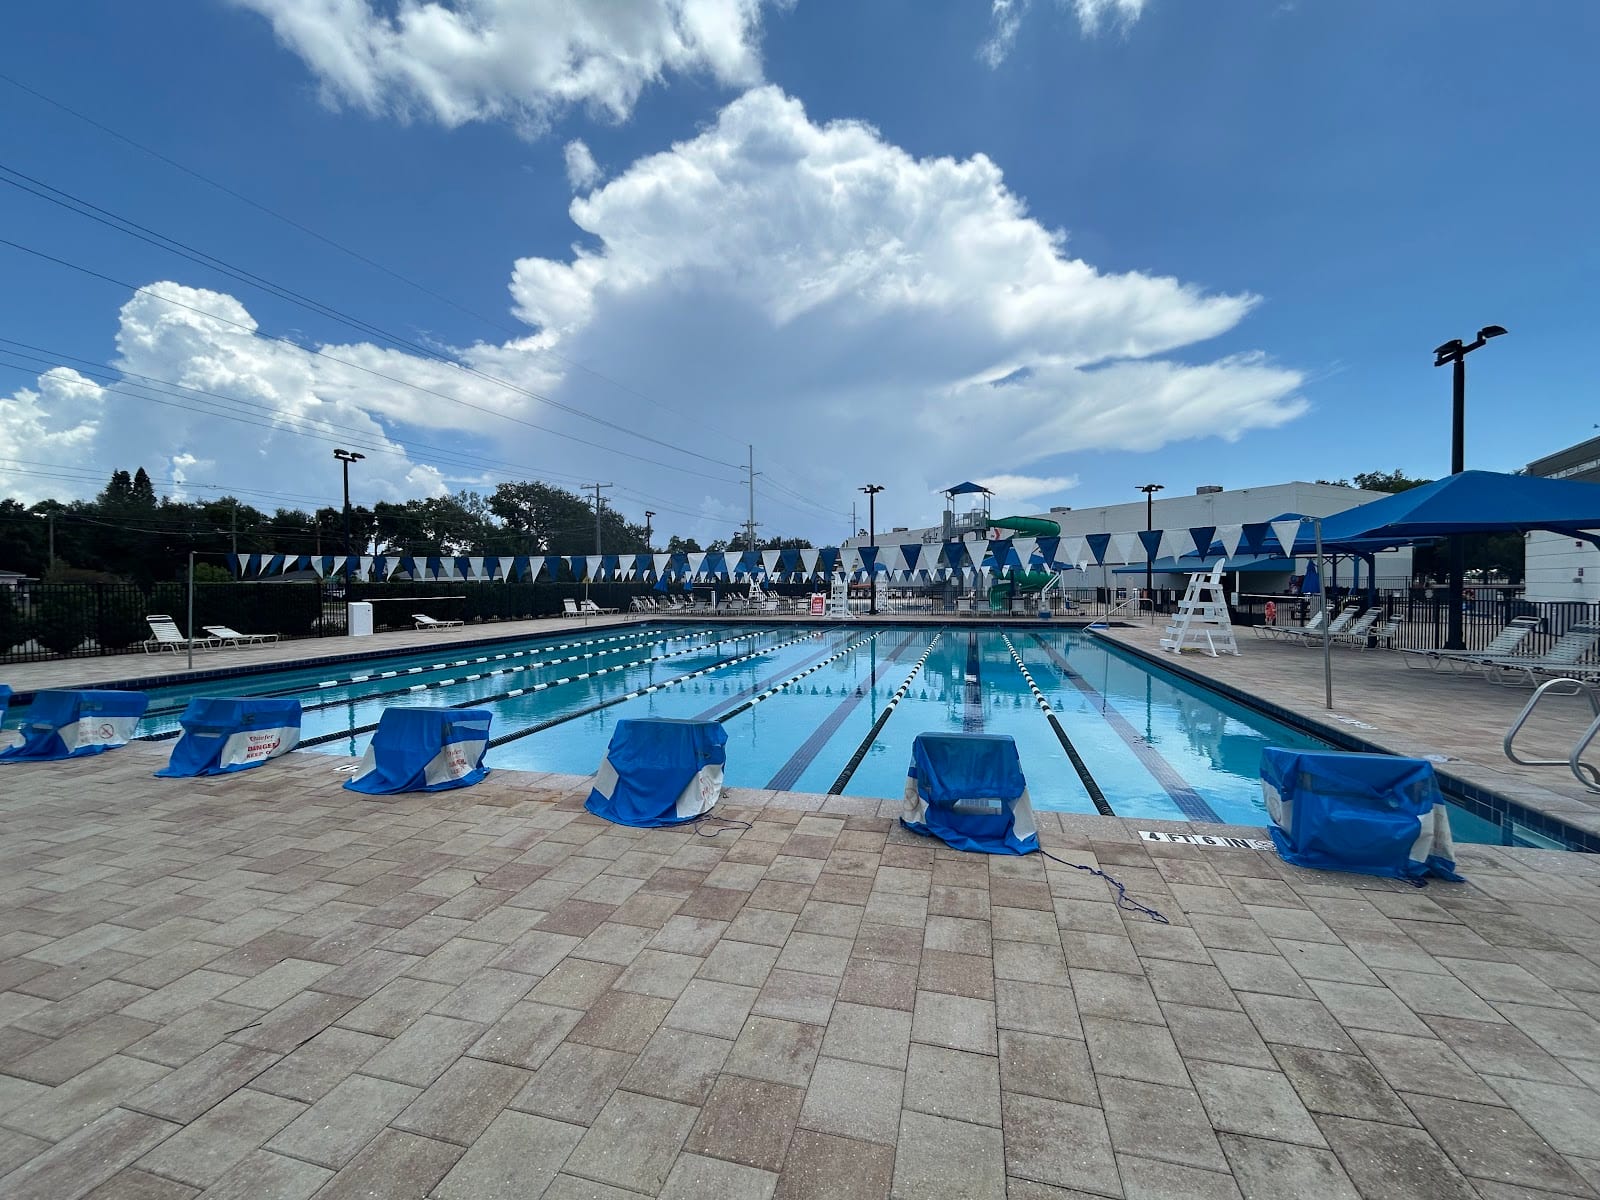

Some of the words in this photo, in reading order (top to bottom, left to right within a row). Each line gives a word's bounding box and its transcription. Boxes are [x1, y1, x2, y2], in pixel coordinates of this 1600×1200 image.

[1149, 832, 1161, 841] 4
[1168, 833, 1191, 843] FT
[1201, 836, 1217, 845] 6
[1225, 838, 1252, 849] IN
